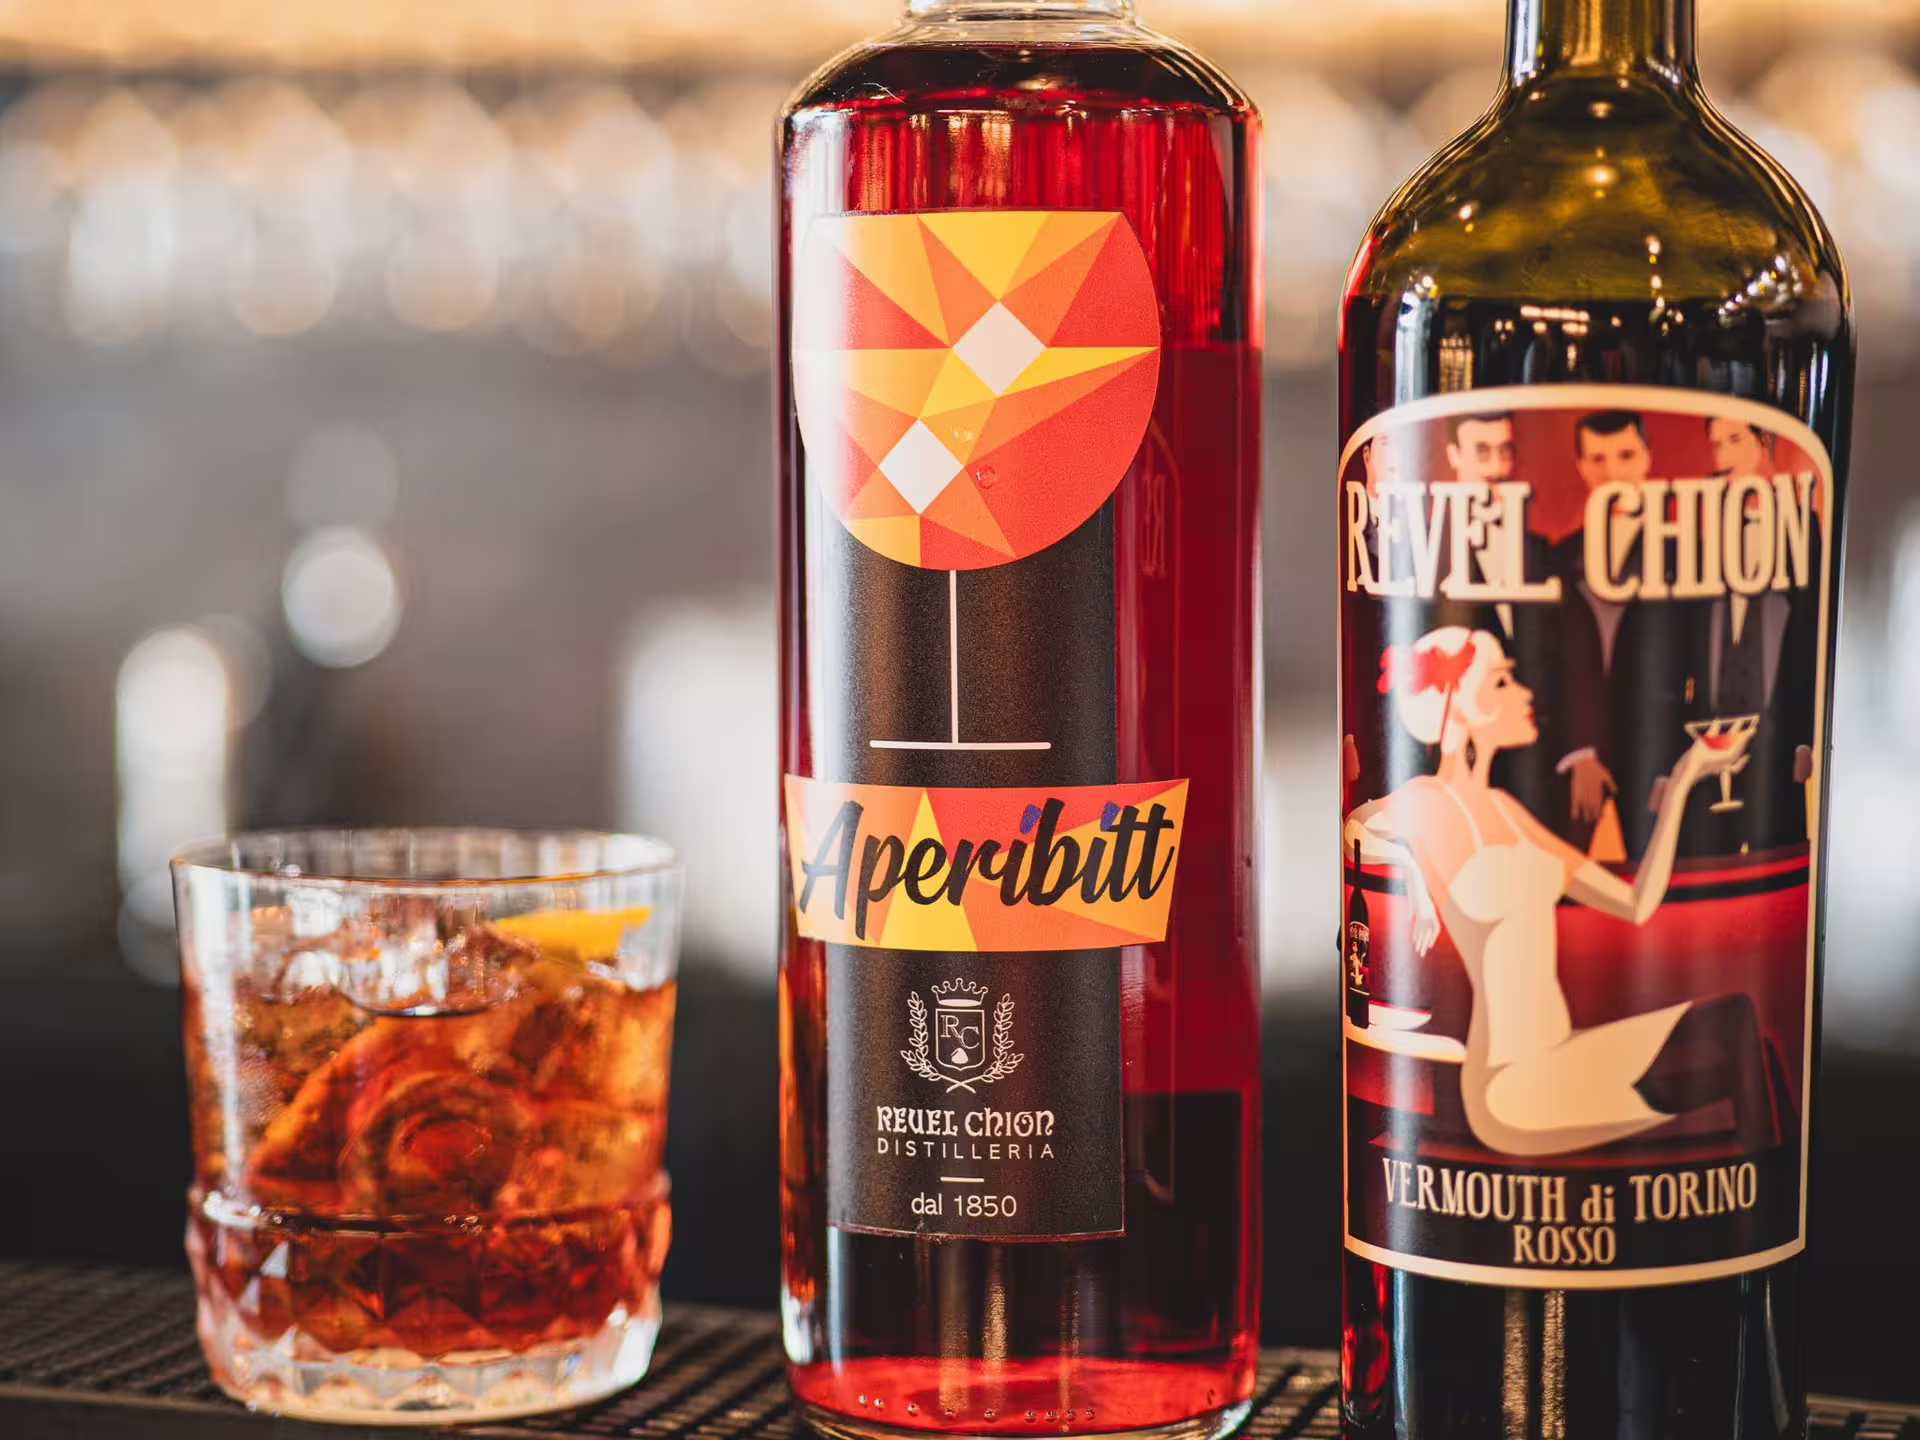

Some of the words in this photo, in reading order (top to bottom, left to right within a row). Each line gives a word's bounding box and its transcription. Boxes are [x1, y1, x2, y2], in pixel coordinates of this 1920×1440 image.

[1345, 480, 1561, 600] REVEL
[1583, 472, 1817, 601] CHION
[799, 798, 1175, 940] Aperibitt
[877, 1138, 1054, 1159] DISTILLERIA
[911, 1193, 942, 1215] dal
[954, 1194, 1017, 1217] 1850
[1382, 1157, 1566, 1223] VERMOUTH
[1581, 1183, 1616, 1223] di
[1629, 1162, 1757, 1223] TORINO
[1513, 1225, 1616, 1265] ROSSO
